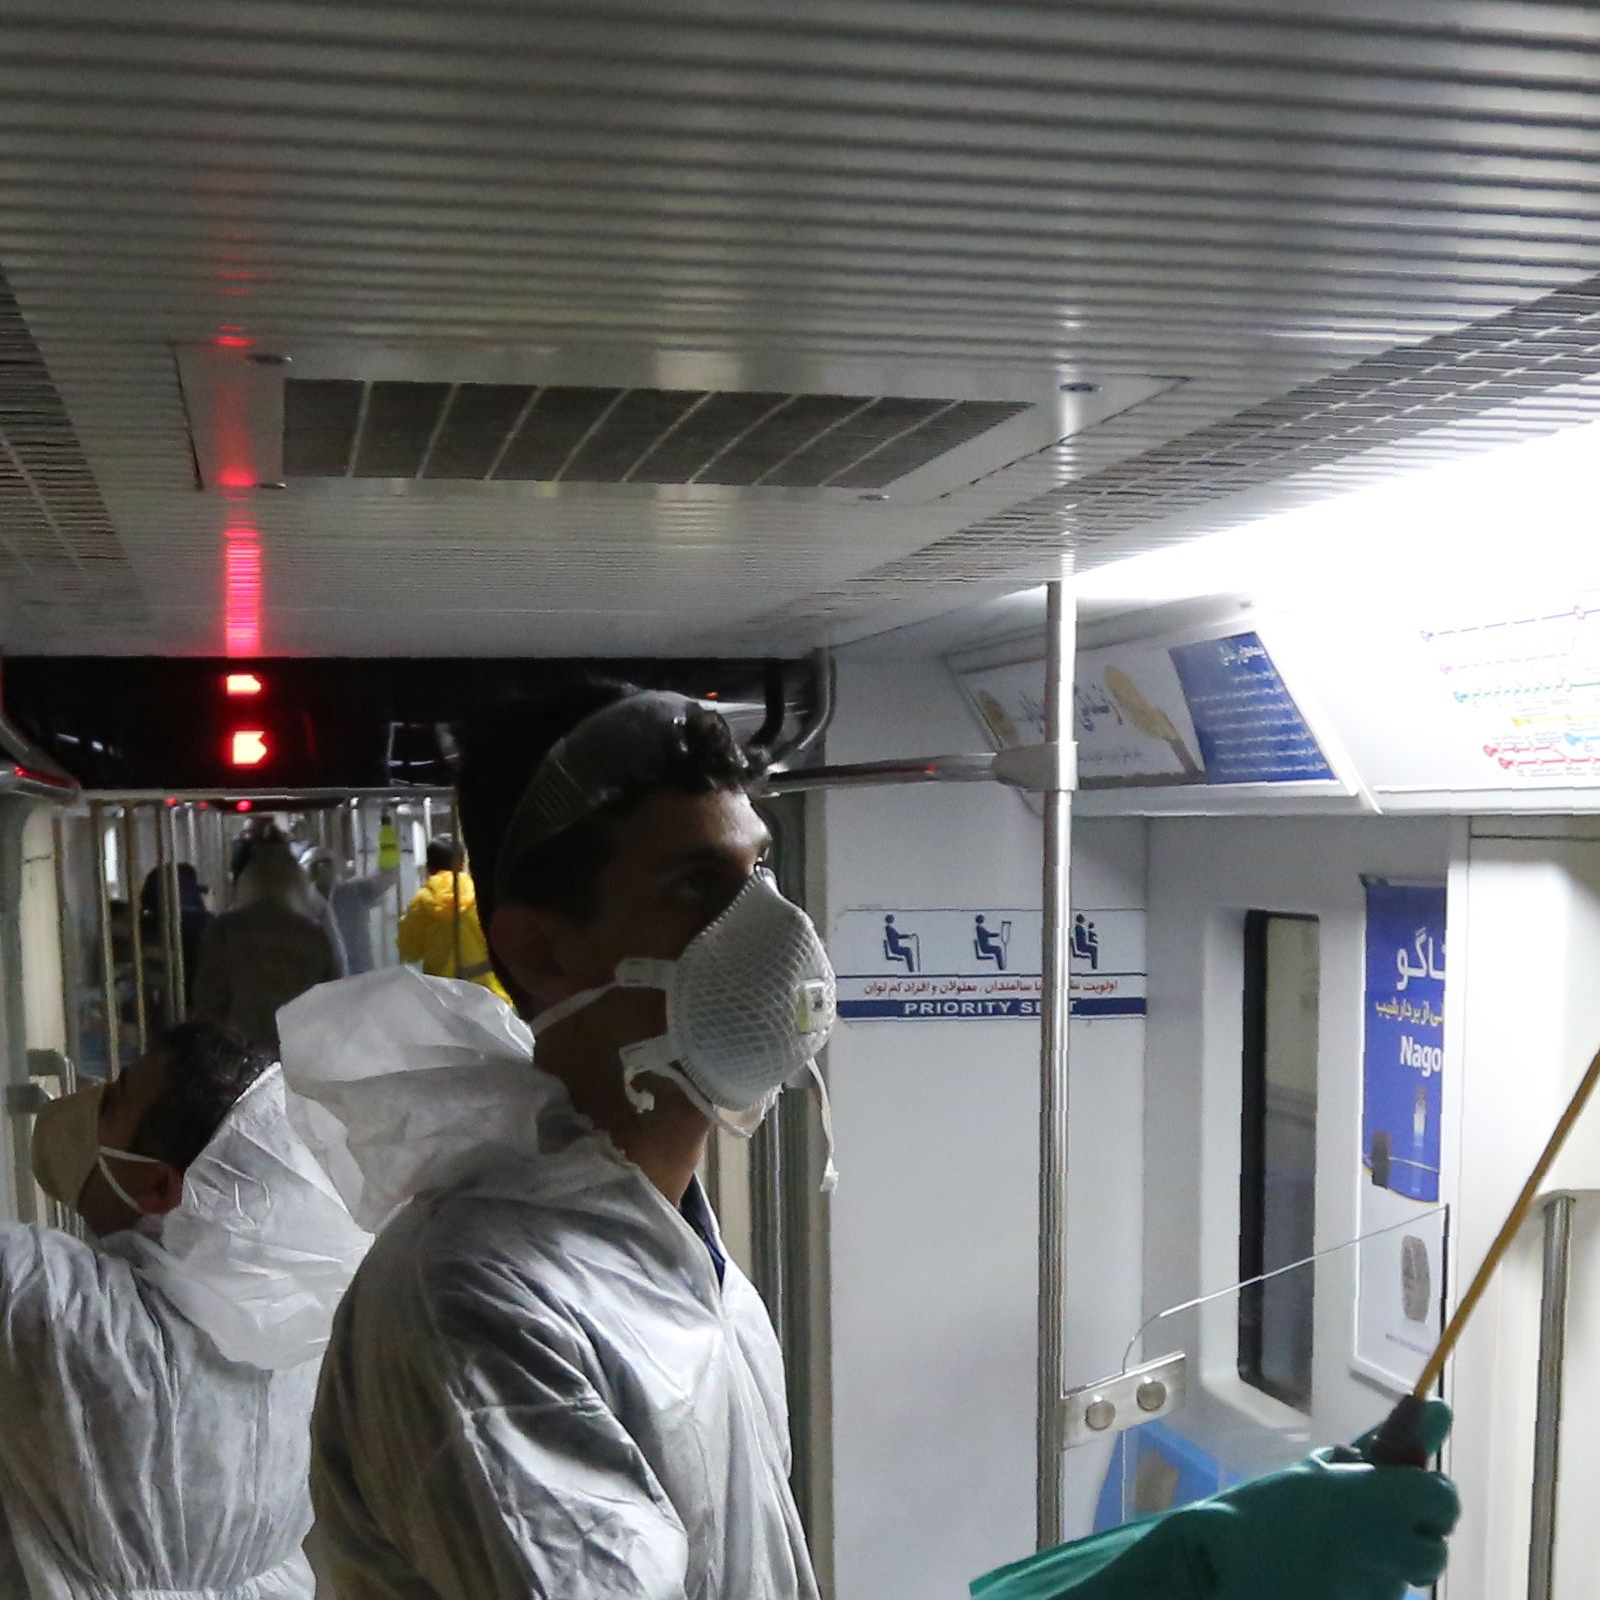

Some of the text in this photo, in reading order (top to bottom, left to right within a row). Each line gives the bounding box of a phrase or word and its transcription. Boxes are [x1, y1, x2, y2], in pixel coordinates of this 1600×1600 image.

[940, 981, 977, 995] معلولان
[905, 1001, 1011, 1014] PRIORITY
[1400, 1035, 1442, 1078] Nago
